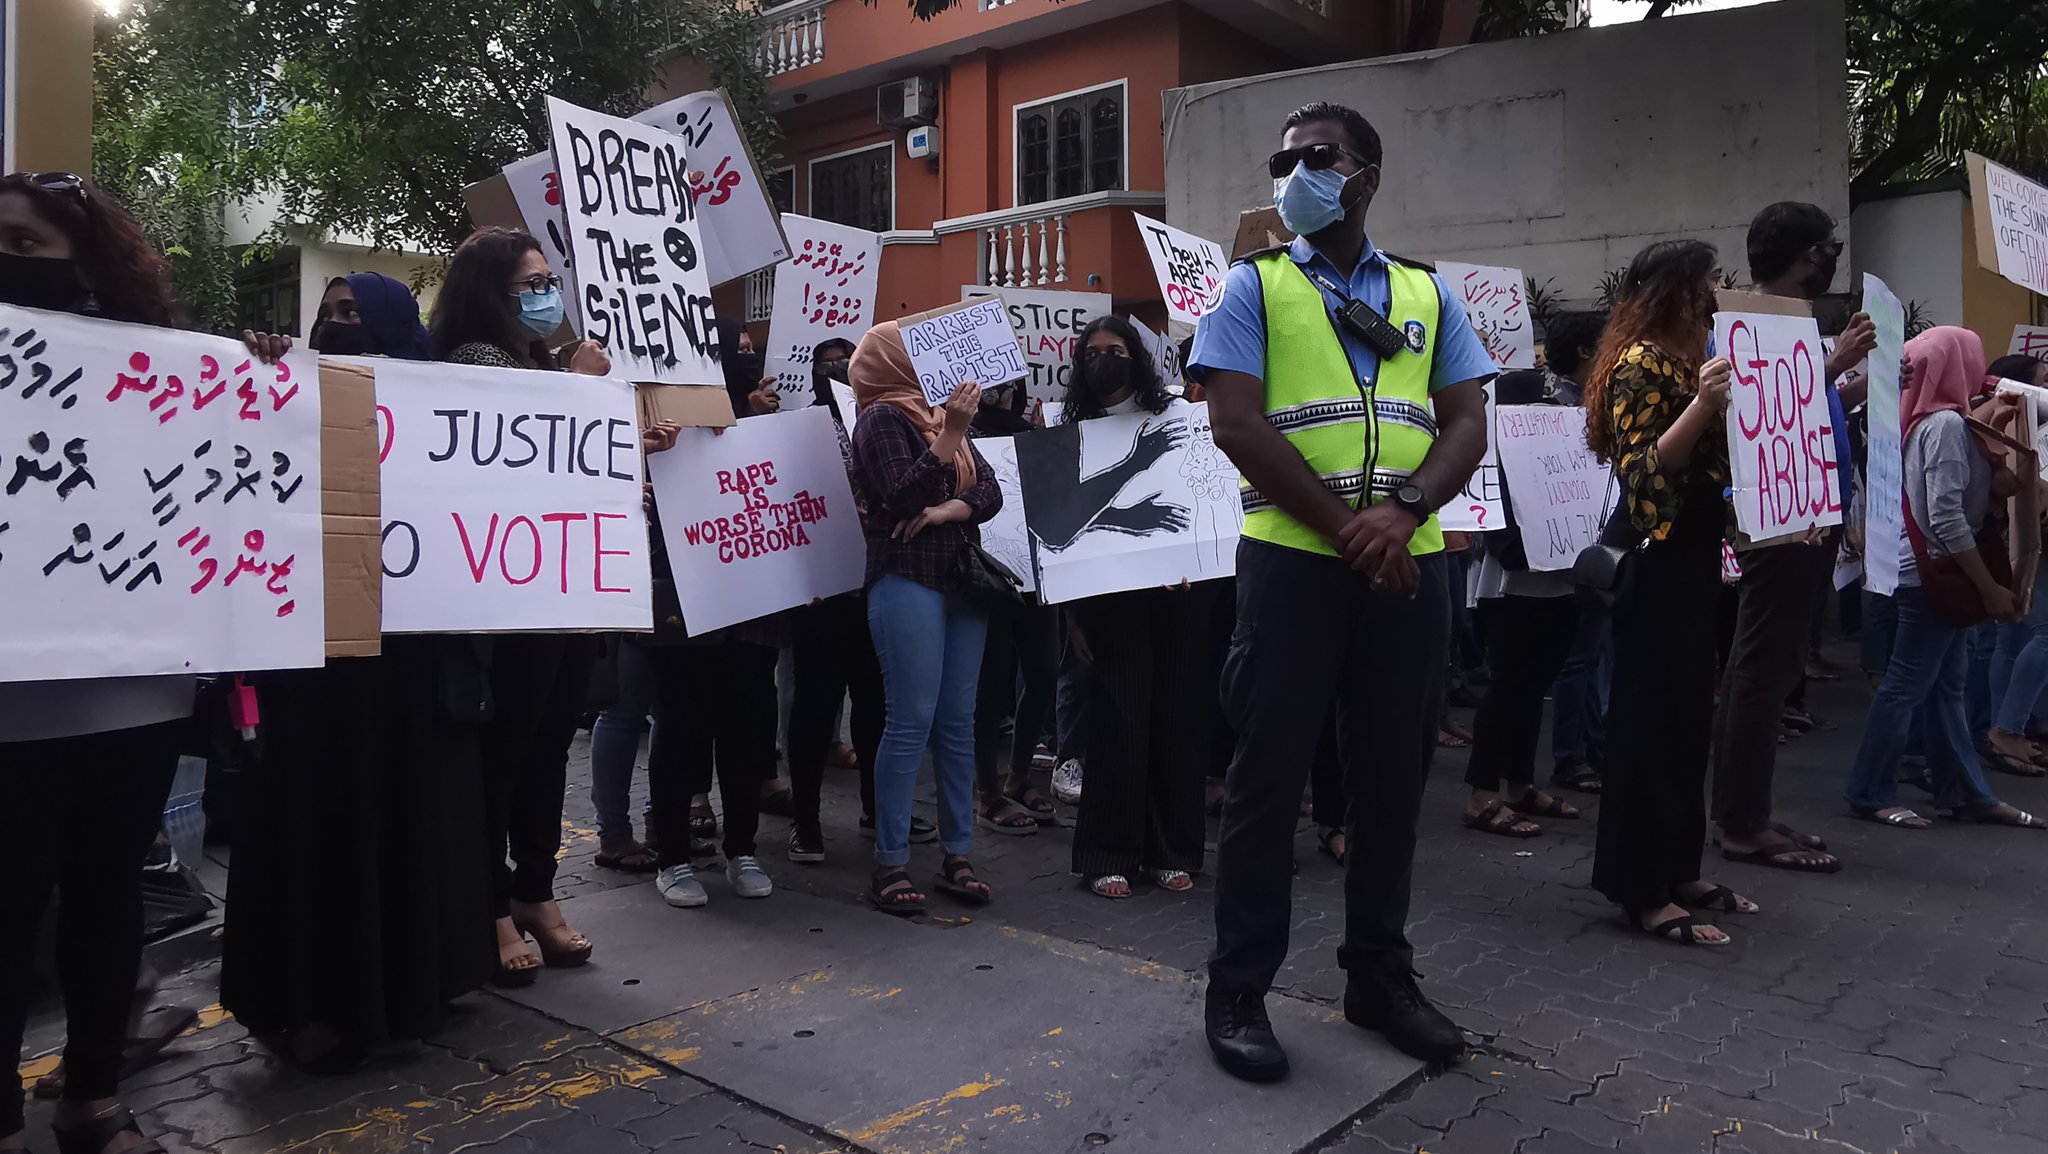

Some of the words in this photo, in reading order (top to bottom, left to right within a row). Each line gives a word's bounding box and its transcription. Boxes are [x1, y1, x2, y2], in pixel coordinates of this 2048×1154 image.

[566, 121, 694, 223] BREAK
[1993, 194, 2018, 223] THE
[1146, 226, 1204, 275] They
[2001, 225, 2018, 248] OF
[586, 227, 660, 286] THE
[1168, 262, 1203, 291] ARE
[908, 303, 1003, 357] ARREST
[939, 334, 982, 362] THE
[1499, 411, 1570, 438] DAUGHTER!
[428, 409, 634, 481] JUSTICE
[1567, 449, 1588, 472] AM
[716, 461, 777, 494] RAPE
[1537, 455, 1566, 476] YOUR
[1758, 425, 1841, 531] ABUSE
[743, 487, 769, 512] IS
[684, 511, 765, 546] WORSE
[719, 524, 811, 563] CORONA
[1546, 516, 1575, 558] MY
[382, 520, 420, 578] O
[451, 512, 631, 594] VOTE
